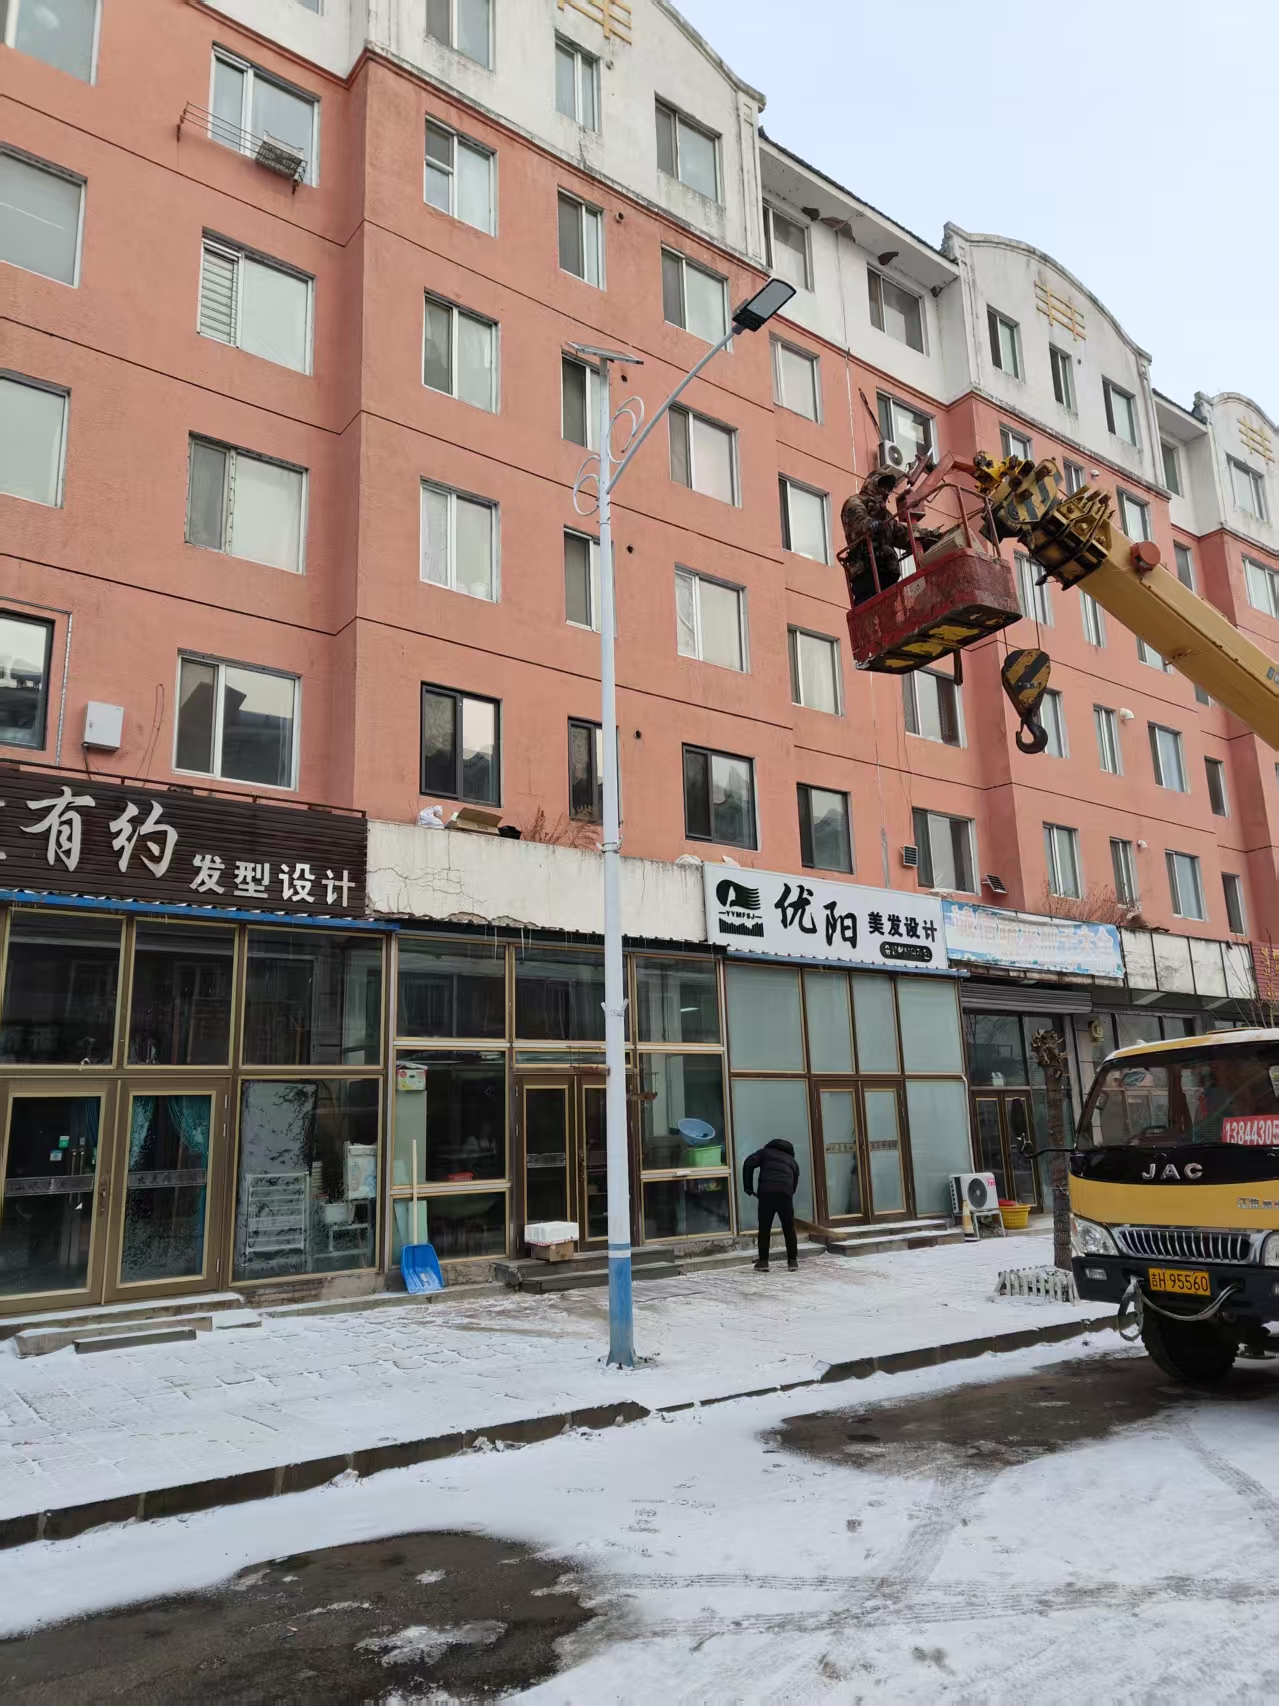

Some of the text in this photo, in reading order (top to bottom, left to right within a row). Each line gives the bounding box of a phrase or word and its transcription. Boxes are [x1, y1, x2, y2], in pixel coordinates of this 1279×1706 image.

[0, 786, 355, 907] 有约 发型设计
[774, 883, 857, 949] 优阳
[867, 912, 937, 942] 美发设计
[1142, 1163, 1203, 1179] JAC
